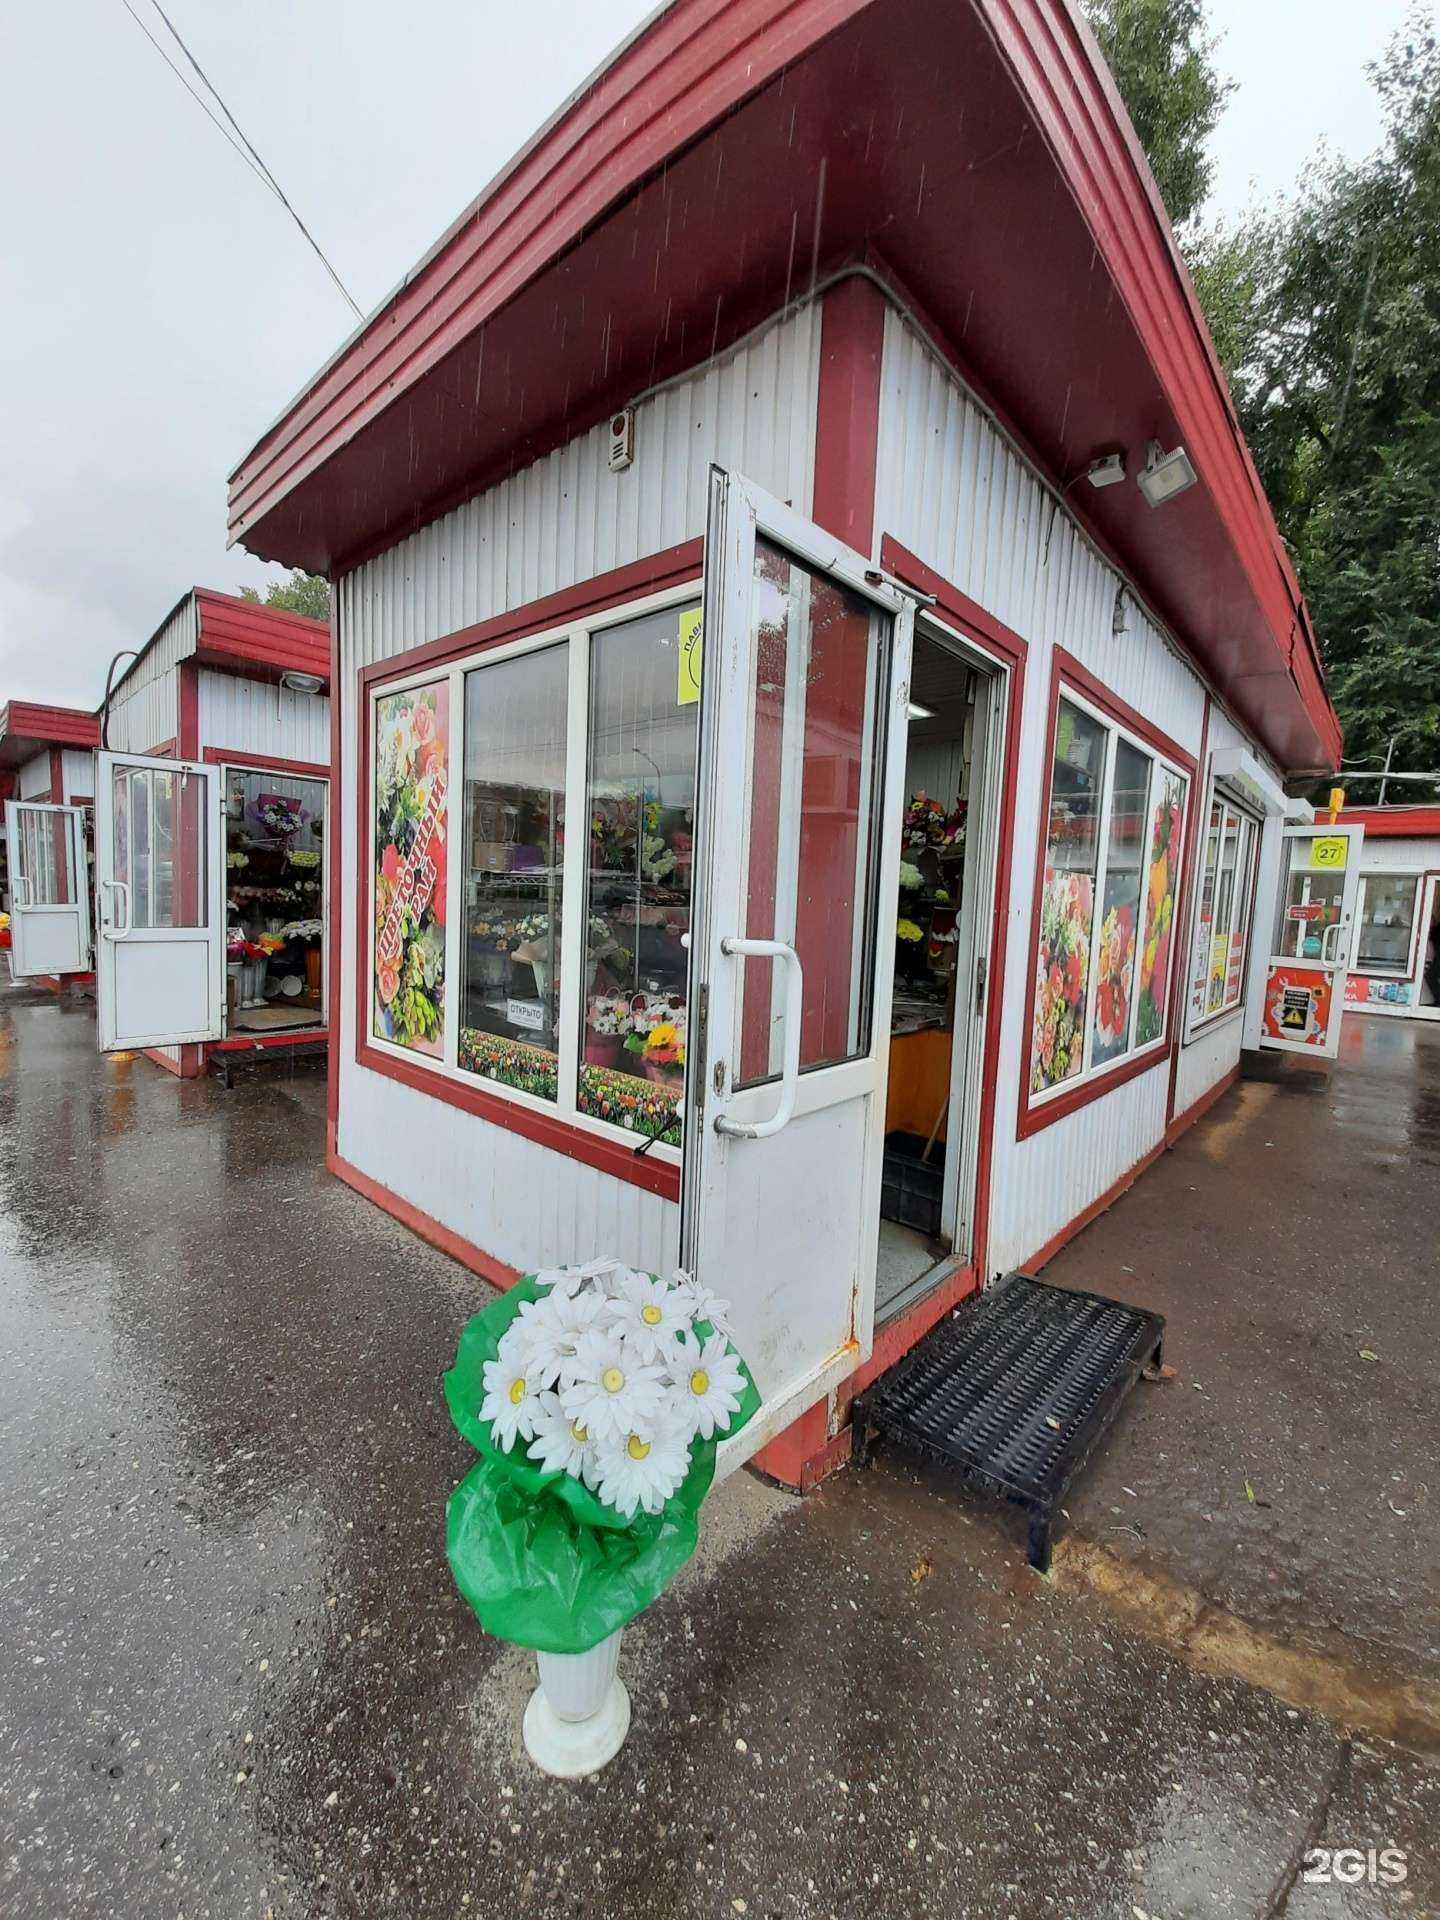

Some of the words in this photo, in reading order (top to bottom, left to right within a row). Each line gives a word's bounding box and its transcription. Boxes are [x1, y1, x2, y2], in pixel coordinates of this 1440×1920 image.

[379, 774, 447, 961] ЦВЕТОЧНЫЙ
[1319, 848, 1338, 859] 27
[411, 856, 437, 926] РАЙ
[511, 1004, 541, 1020] ОТКРЫТО
